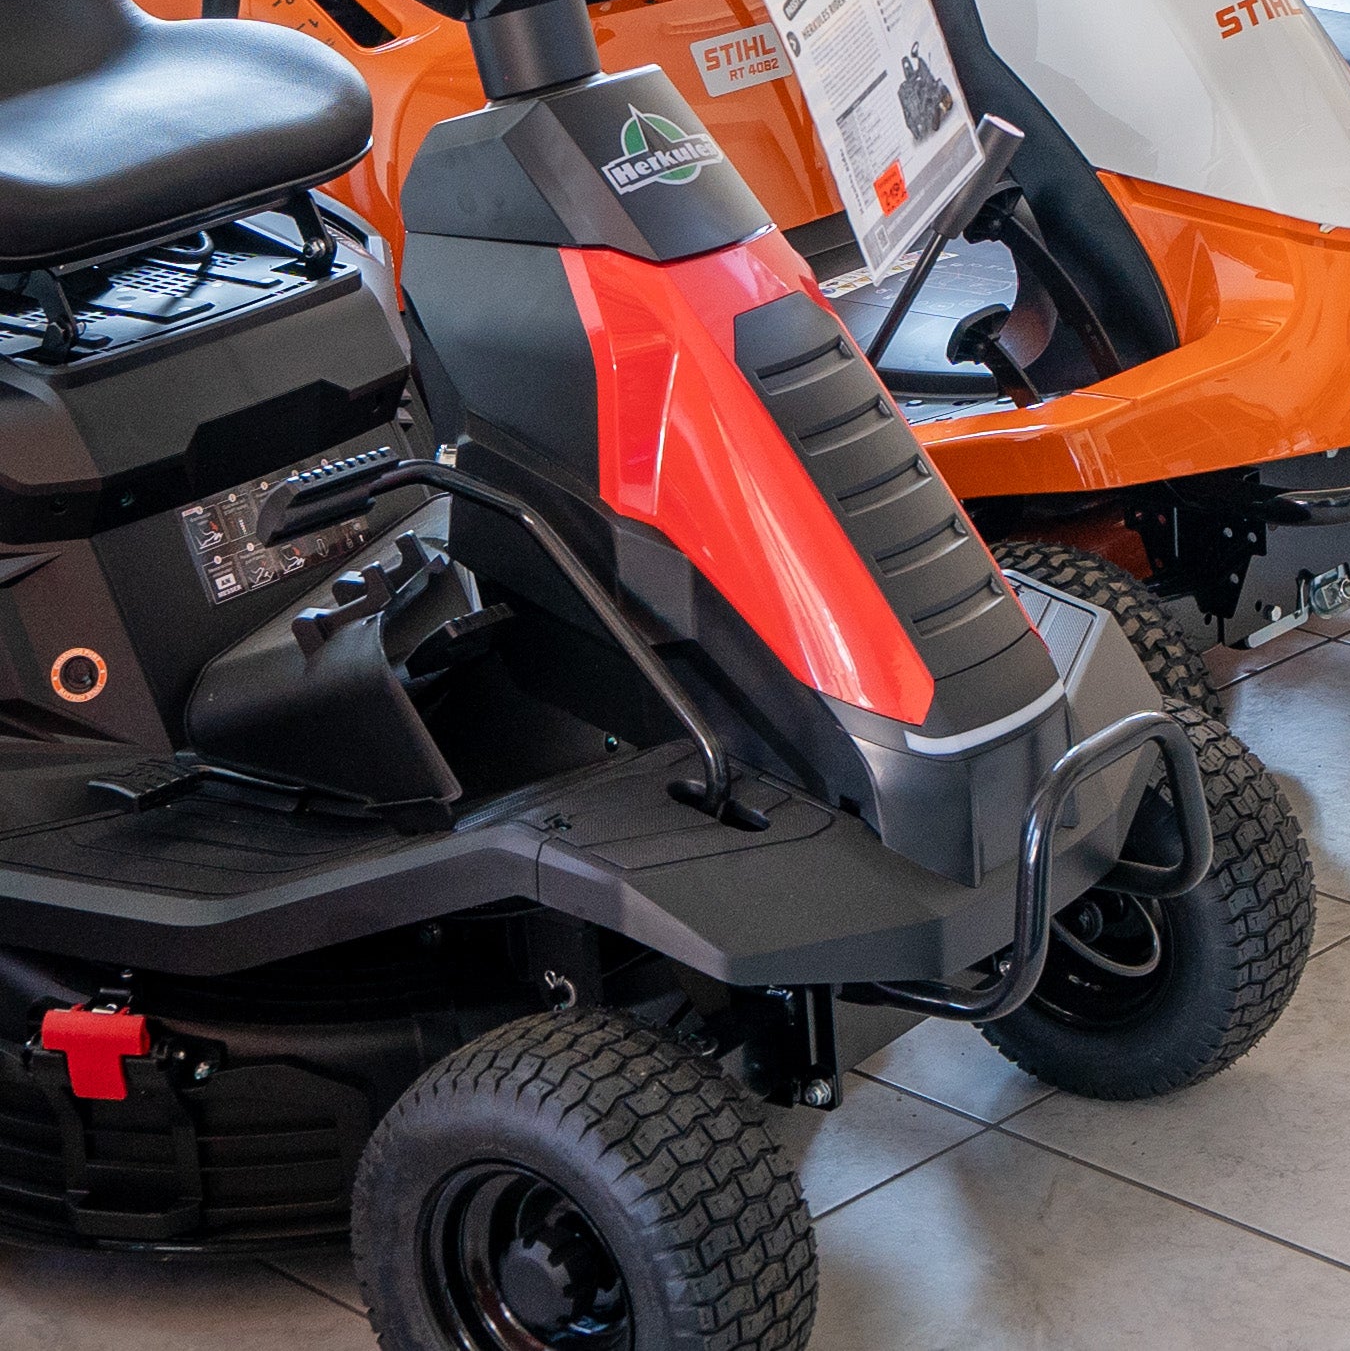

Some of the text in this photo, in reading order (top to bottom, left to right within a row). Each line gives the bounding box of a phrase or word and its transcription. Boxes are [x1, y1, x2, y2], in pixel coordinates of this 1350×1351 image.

[801, 2, 832, 40] HERKULES
[704, 34, 777, 71] STIHL
[728, 57, 780, 82] RT 4082
